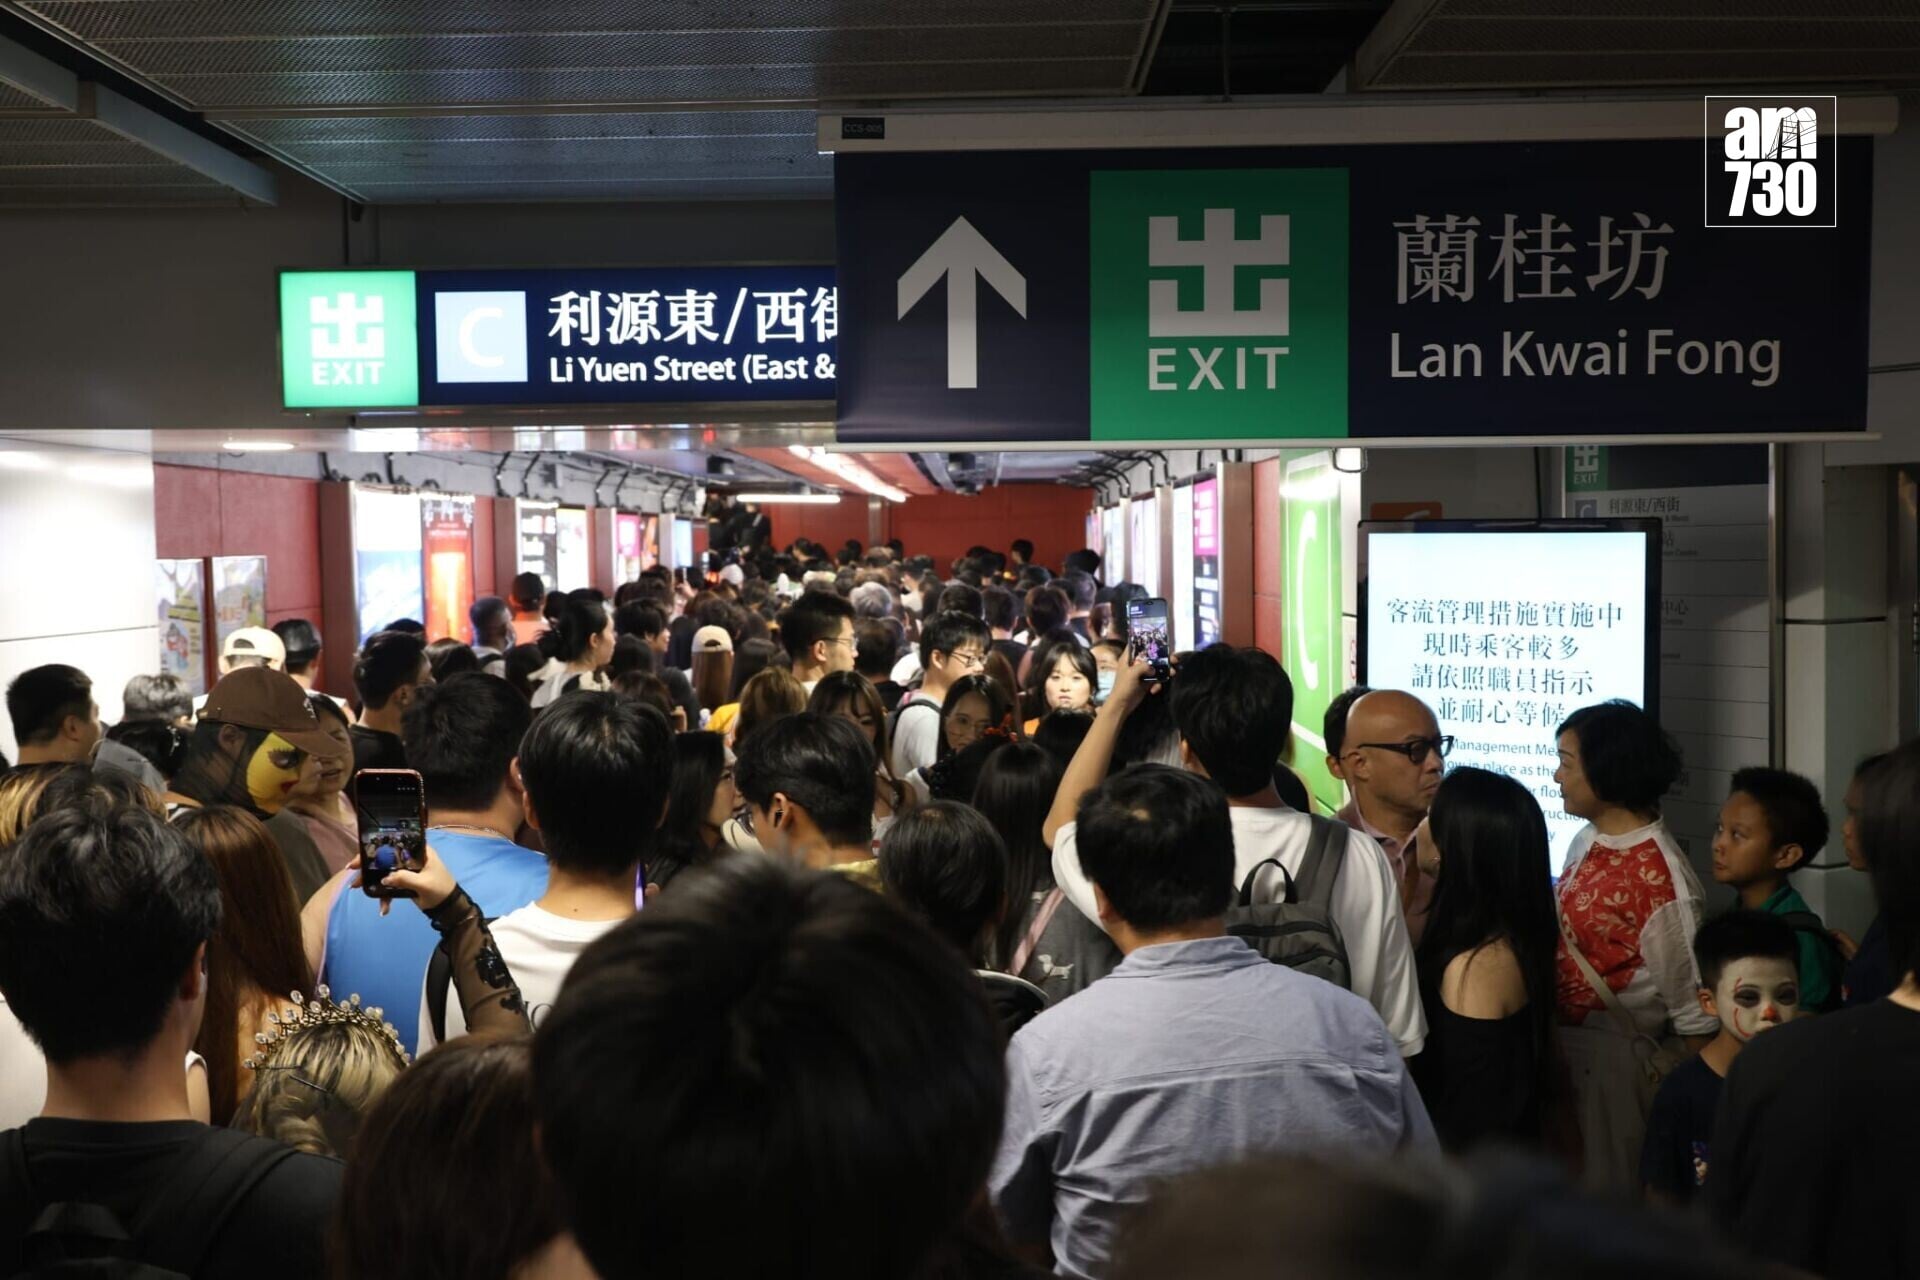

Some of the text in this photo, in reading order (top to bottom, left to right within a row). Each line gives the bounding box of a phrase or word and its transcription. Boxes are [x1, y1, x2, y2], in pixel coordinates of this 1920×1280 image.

[1392, 212, 1675, 305] 蘭桂坊
[458, 307, 505, 368] C
[311, 361, 385, 386] EXIT
[550, 353, 836, 384] Li Yuen Street (East &
[1148, 346, 1290, 391] EXIT
[1390, 328, 1782, 388] Lan Kwai Fong
[1573, 472, 1599, 485] EXIT
[1386, 598, 1622, 629] 客流管理措施實施中
[1411, 663, 1594, 696] 請依照職員指示
[1437, 697, 1566, 728] 並耐心等候
[1520, 764, 1534, 776] as
